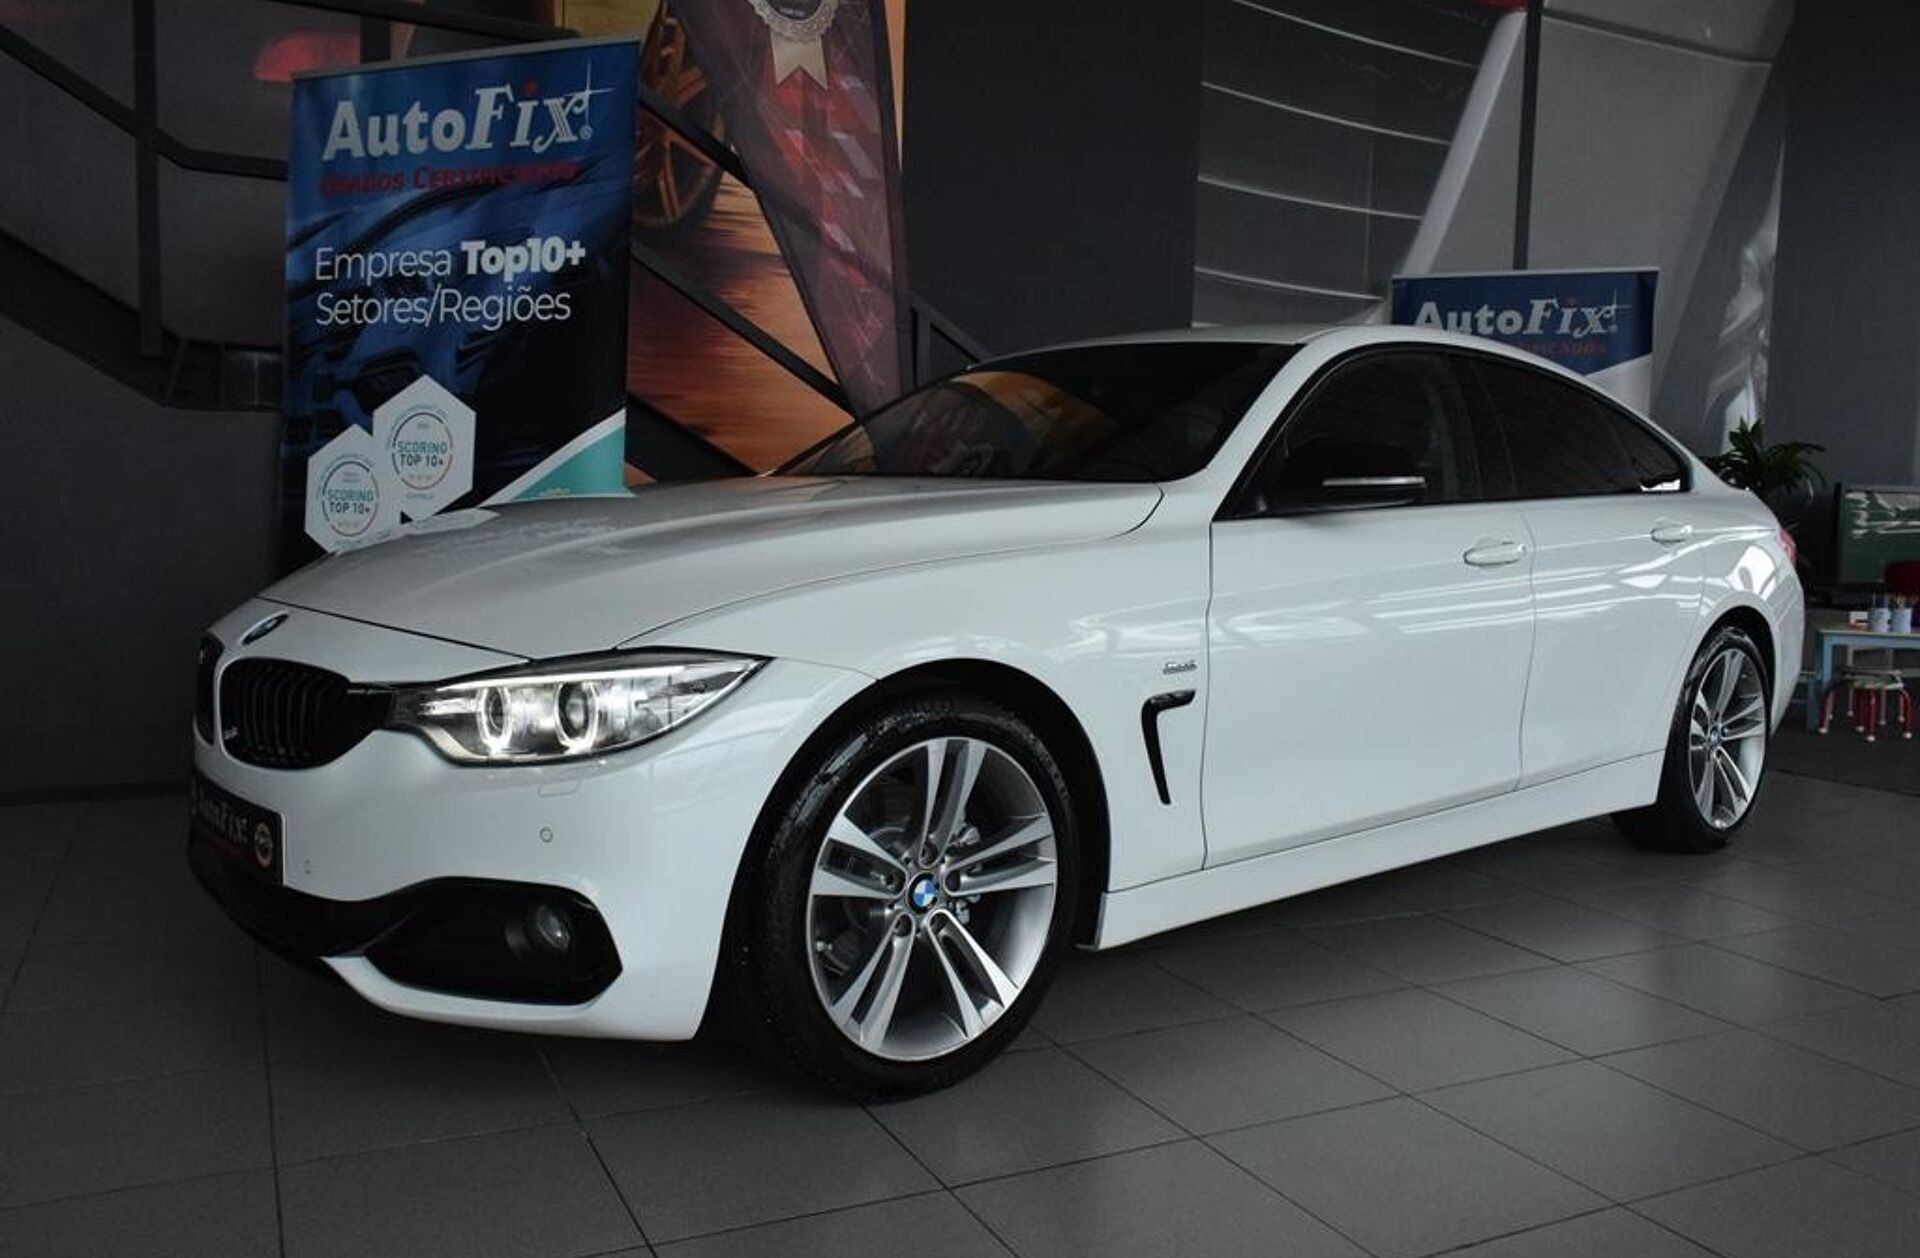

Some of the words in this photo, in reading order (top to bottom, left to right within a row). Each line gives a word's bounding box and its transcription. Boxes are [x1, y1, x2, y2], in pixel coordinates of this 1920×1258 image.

[315, 247, 451, 285] Empresa
[460, 236, 586, 282] Top10+
[315, 283, 572, 332] Setores/Regiões
[400, 454, 422, 467] TOP
[329, 502, 350, 514] TOP
